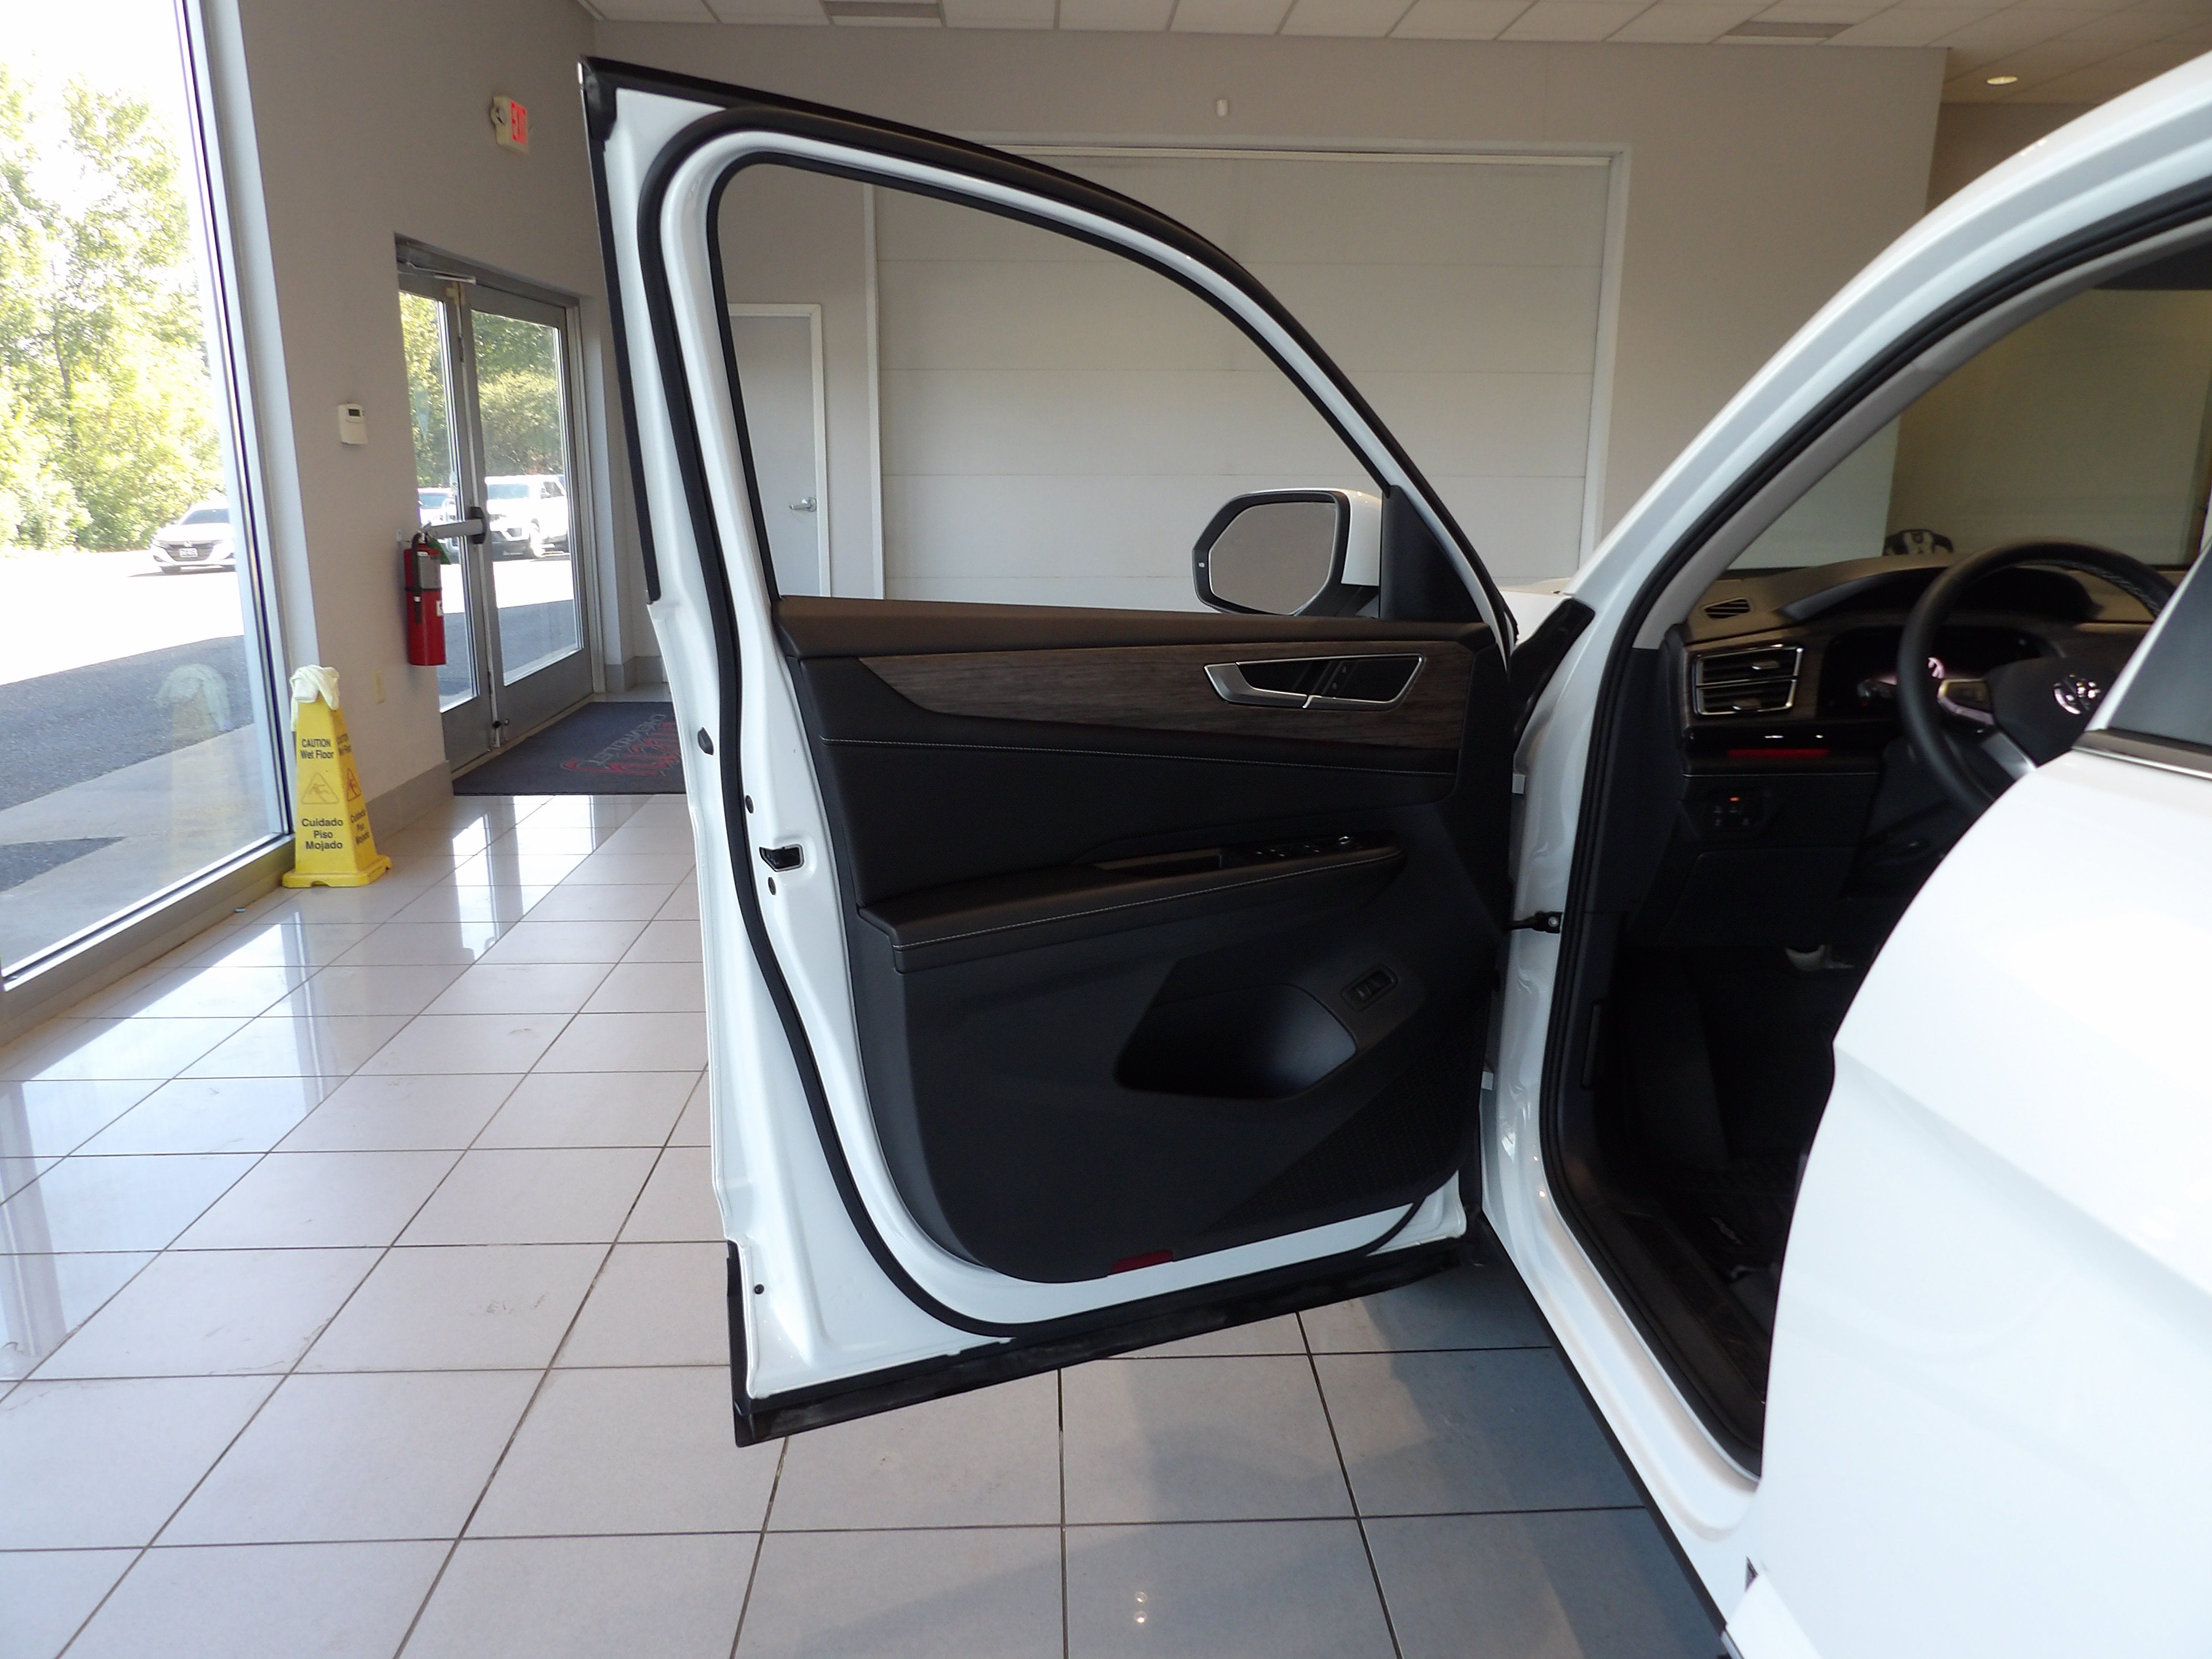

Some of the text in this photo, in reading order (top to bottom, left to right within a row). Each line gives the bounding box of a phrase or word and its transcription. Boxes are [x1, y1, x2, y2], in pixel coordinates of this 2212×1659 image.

[301, 738, 331, 747] CAUTION
[300, 750, 314, 759] Wet
[316, 750, 334, 758] Floor
[301, 818, 343, 827] Cuidado
[313, 830, 333, 839] Piso
[306, 841, 343, 851] Mojado
